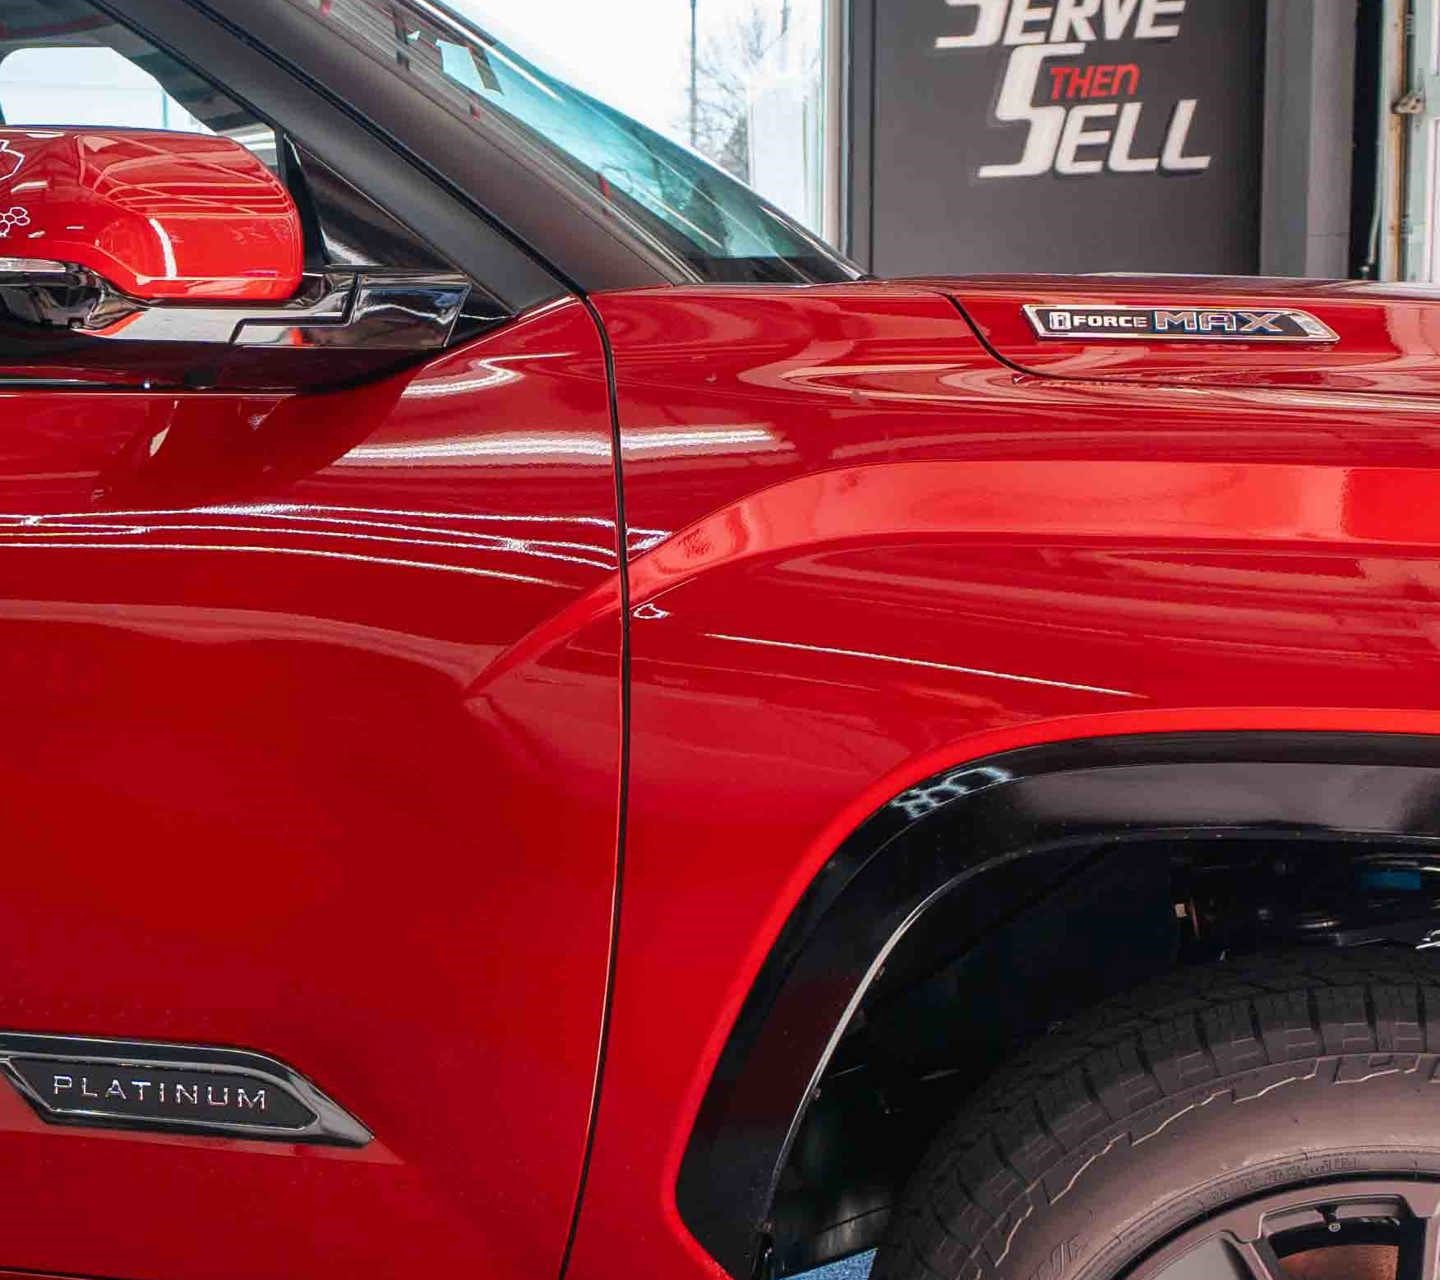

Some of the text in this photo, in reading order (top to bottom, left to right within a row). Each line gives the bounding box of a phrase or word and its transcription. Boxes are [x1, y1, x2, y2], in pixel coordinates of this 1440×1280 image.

[1049, 63, 1141, 99] THEN
[977, 42, 1212, 178] SELL
[1154, 311, 1283, 332] MAX
[53, 1075, 267, 1111] PLATINUM
